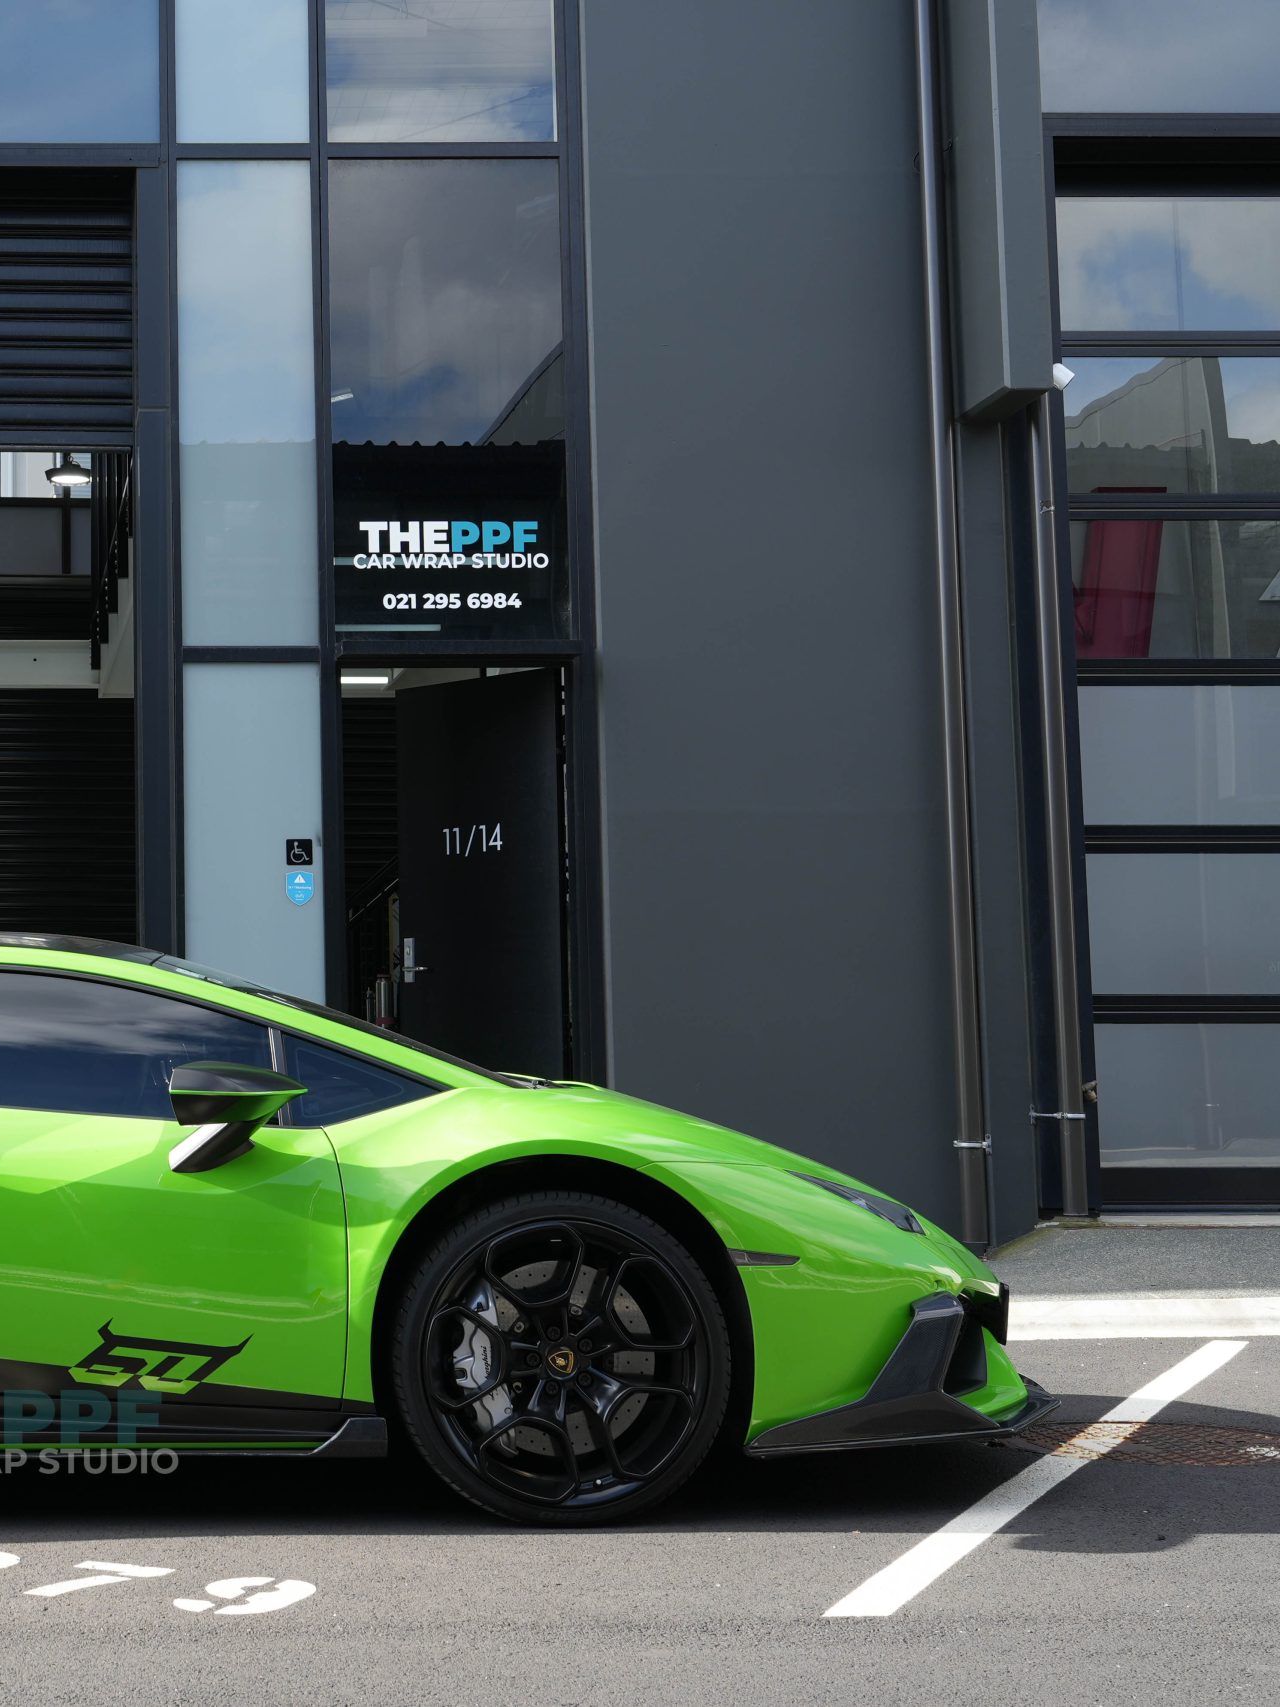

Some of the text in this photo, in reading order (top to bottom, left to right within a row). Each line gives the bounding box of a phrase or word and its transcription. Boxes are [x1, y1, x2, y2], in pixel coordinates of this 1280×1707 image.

[359, 521, 538, 553] THEPPF
[353, 553, 549, 569] CAR WRAP STUDIO
[382, 592, 522, 610] 021 295 6984
[442, 823, 503, 857] 11/14
